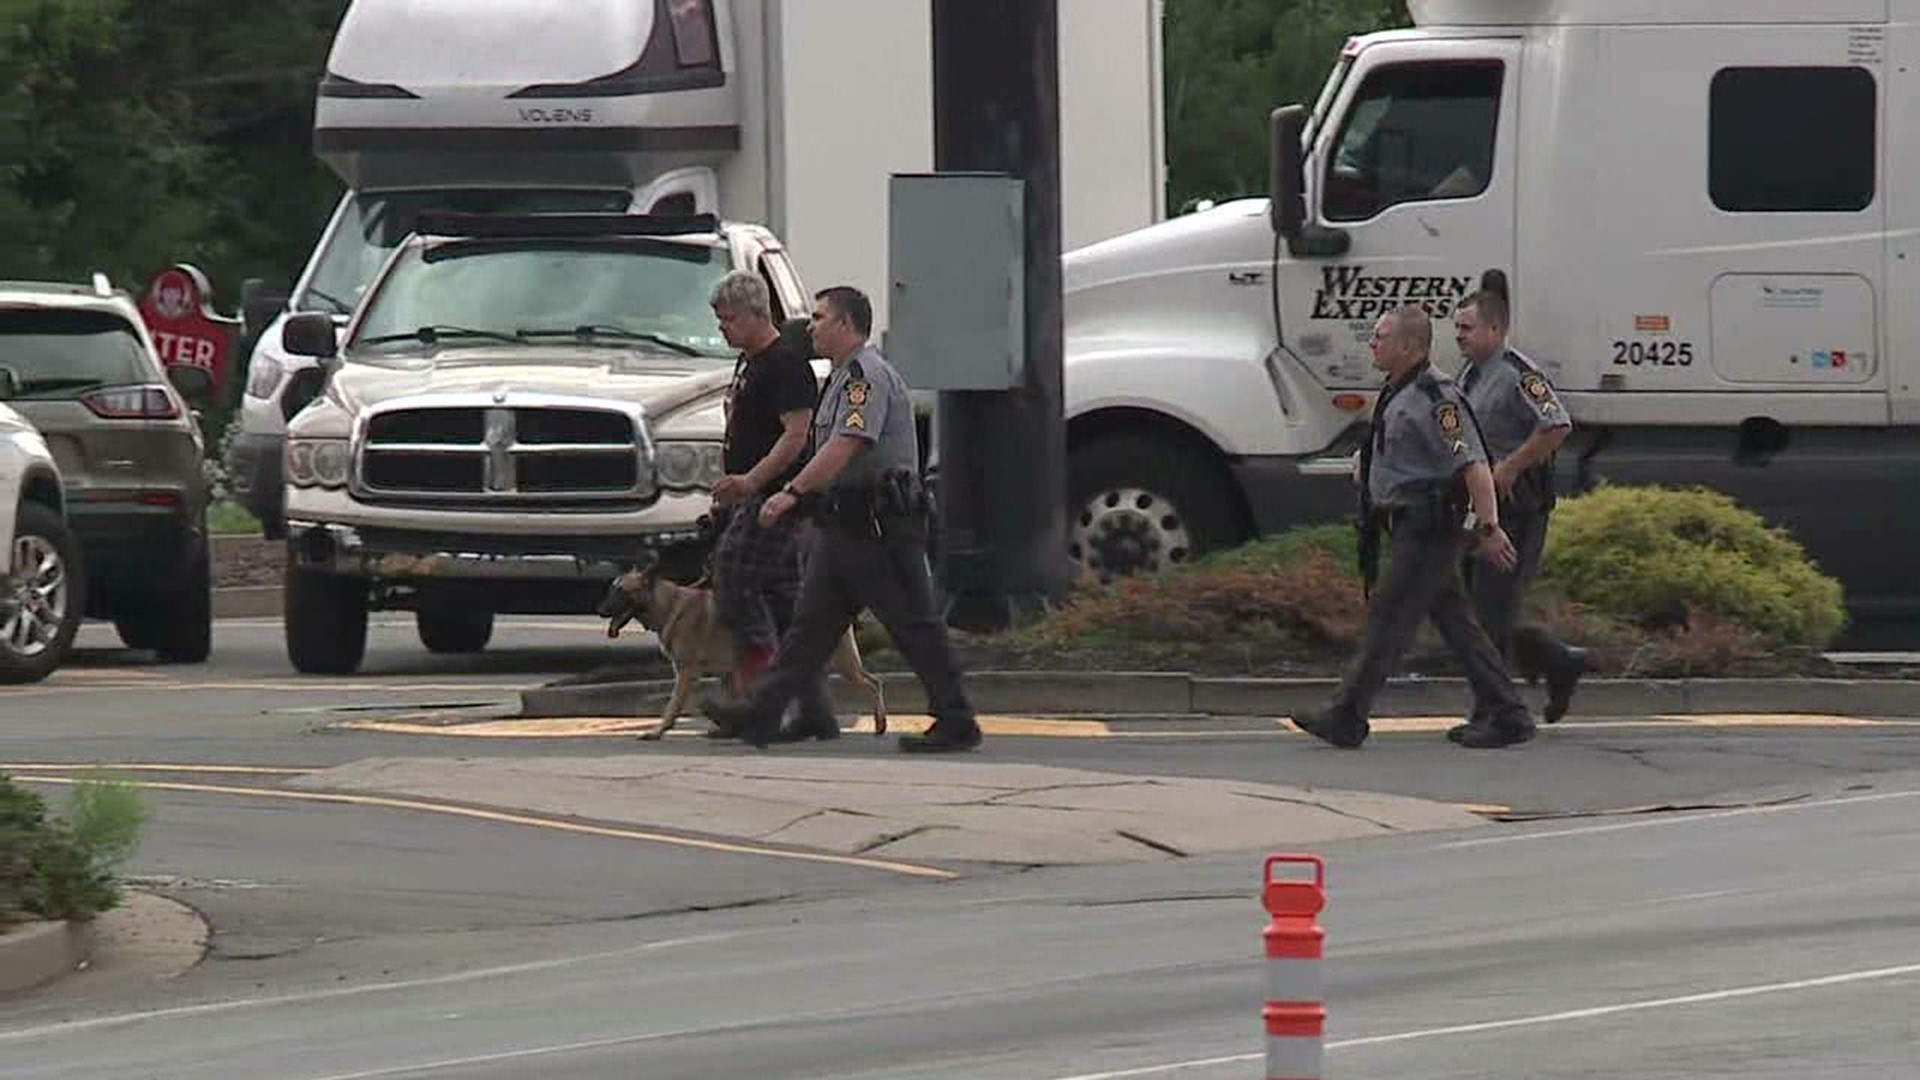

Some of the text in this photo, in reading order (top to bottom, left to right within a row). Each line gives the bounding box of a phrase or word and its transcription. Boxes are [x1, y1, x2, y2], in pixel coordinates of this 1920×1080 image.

[1321, 265, 1473, 298] WESTERN
[1310, 290, 1453, 319] EXPRSS
[150, 330, 215, 367] TER
[1612, 341, 1693, 366] 20425
